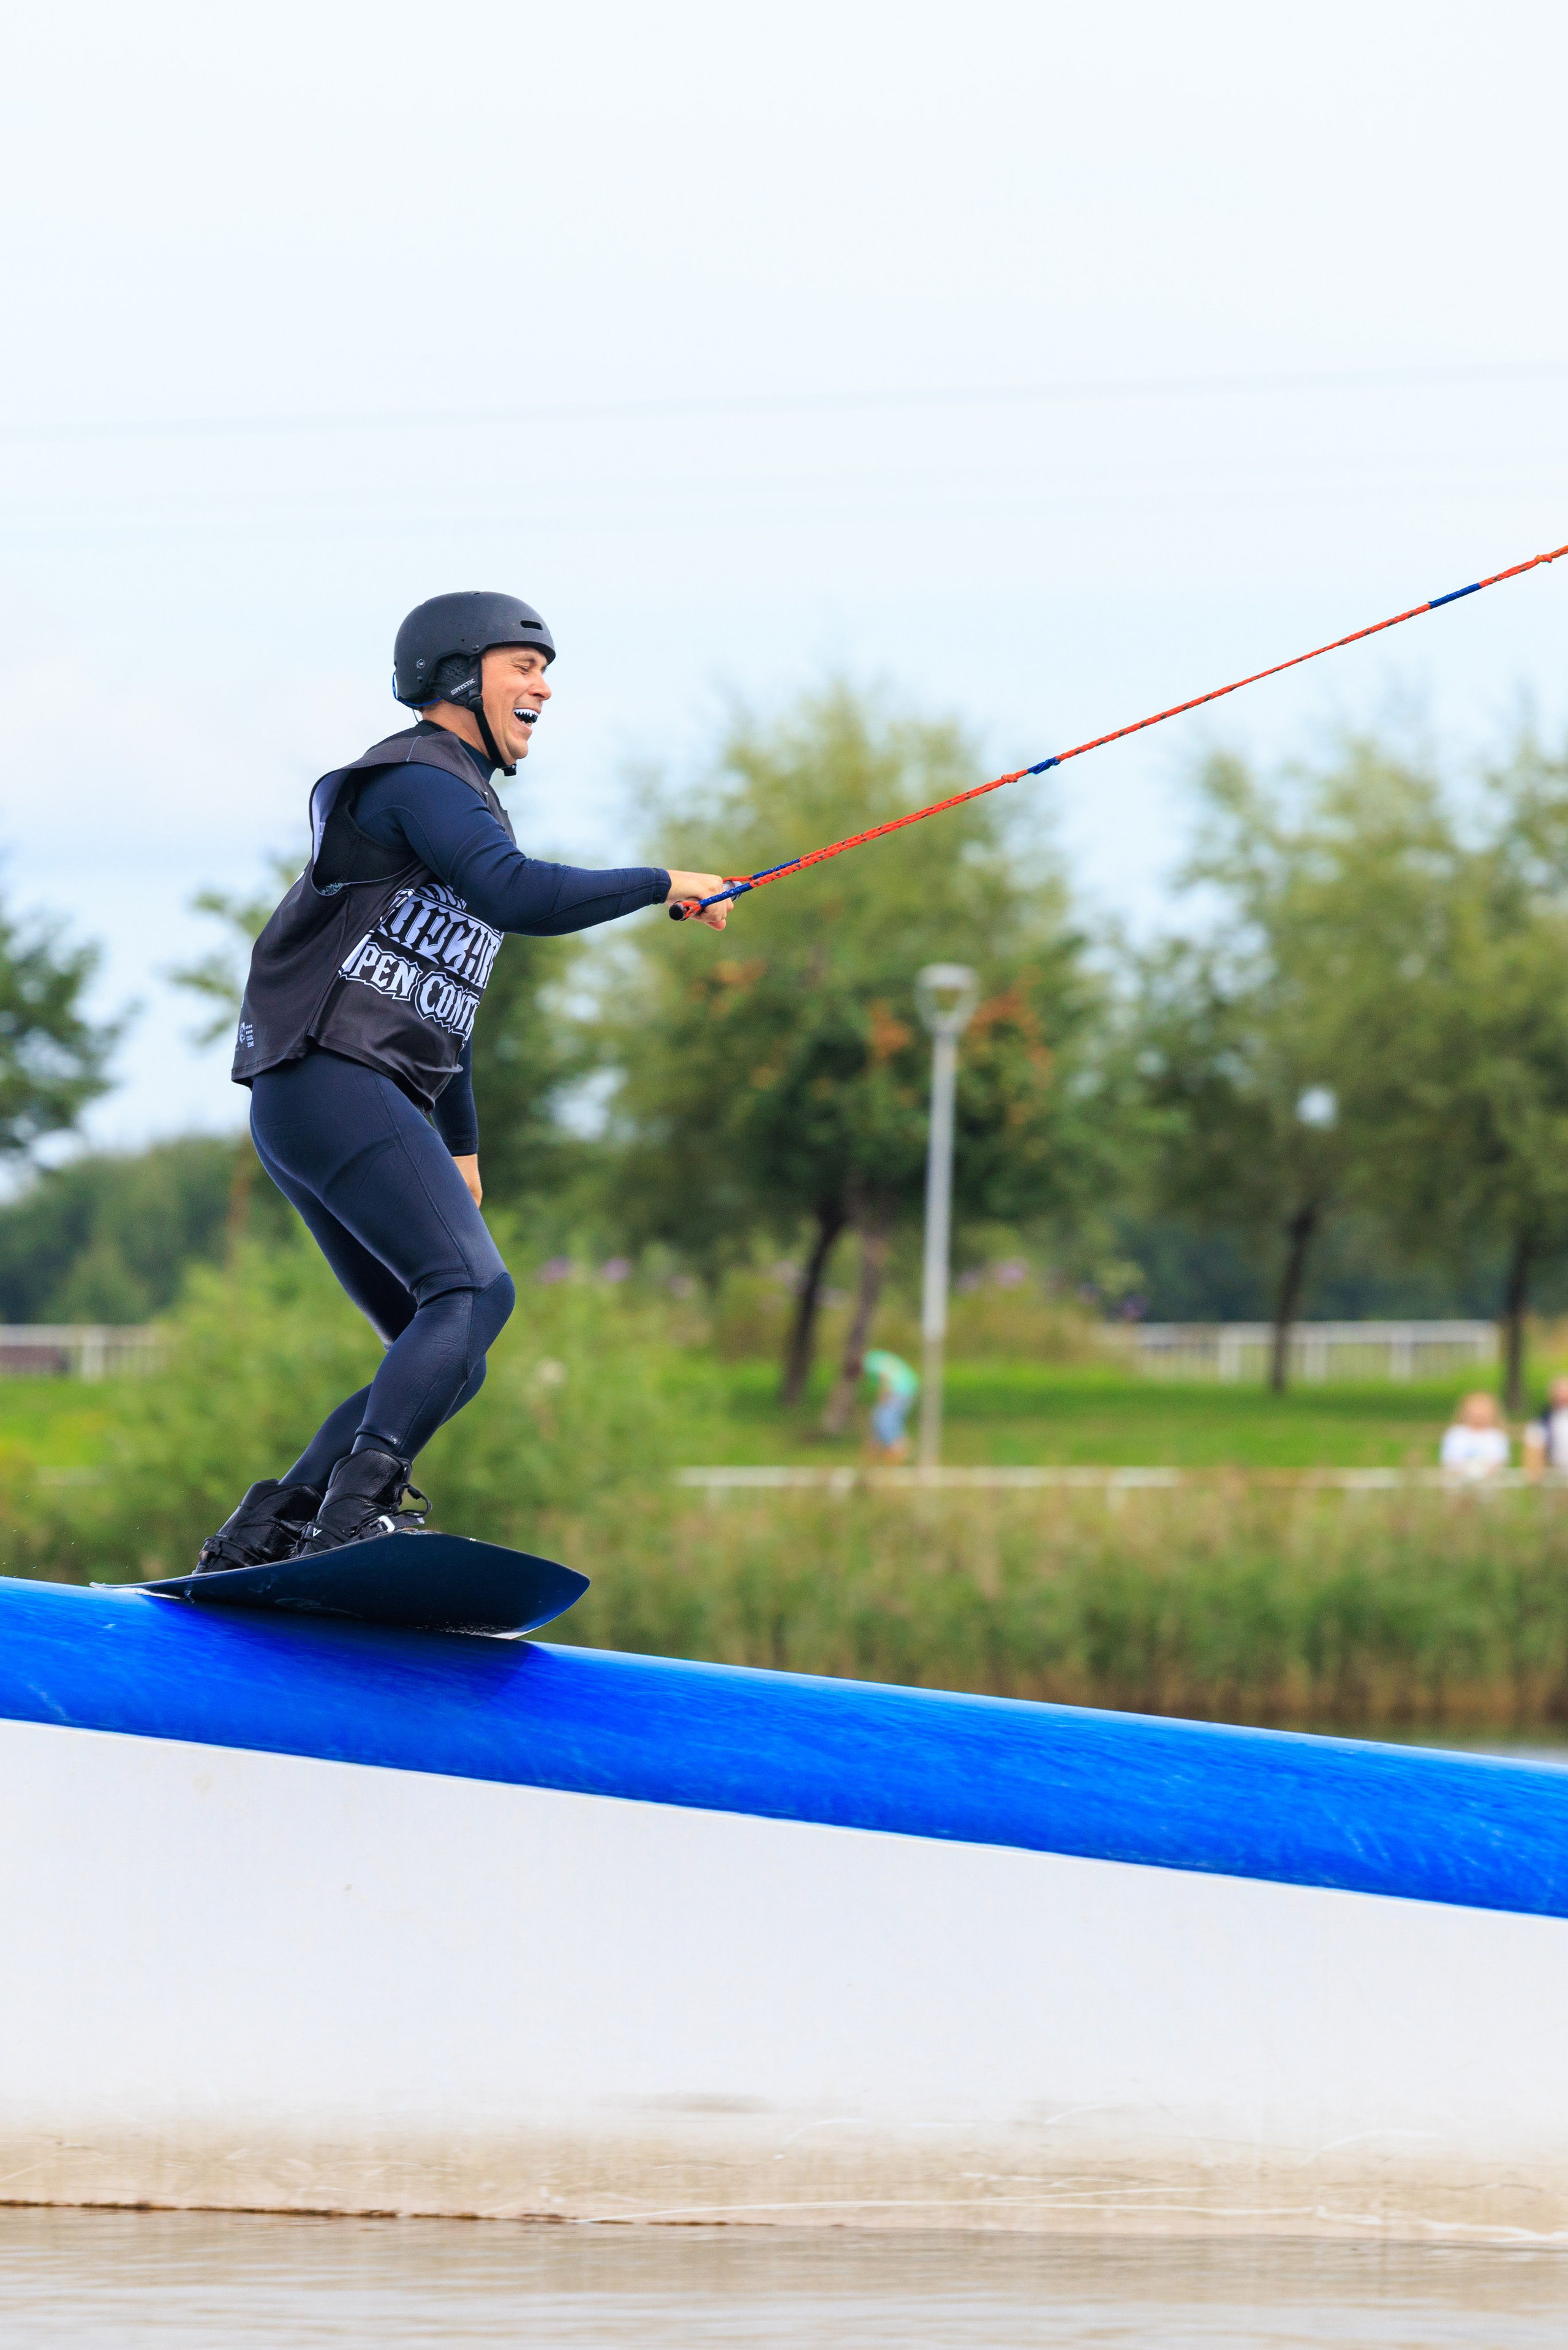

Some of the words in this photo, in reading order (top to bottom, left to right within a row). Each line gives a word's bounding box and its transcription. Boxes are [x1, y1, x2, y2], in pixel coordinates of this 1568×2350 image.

[455, 678, 476, 692] MYSTIC
[378, 896, 497, 988] UPCHI
[420, 975, 480, 1035] CONT
